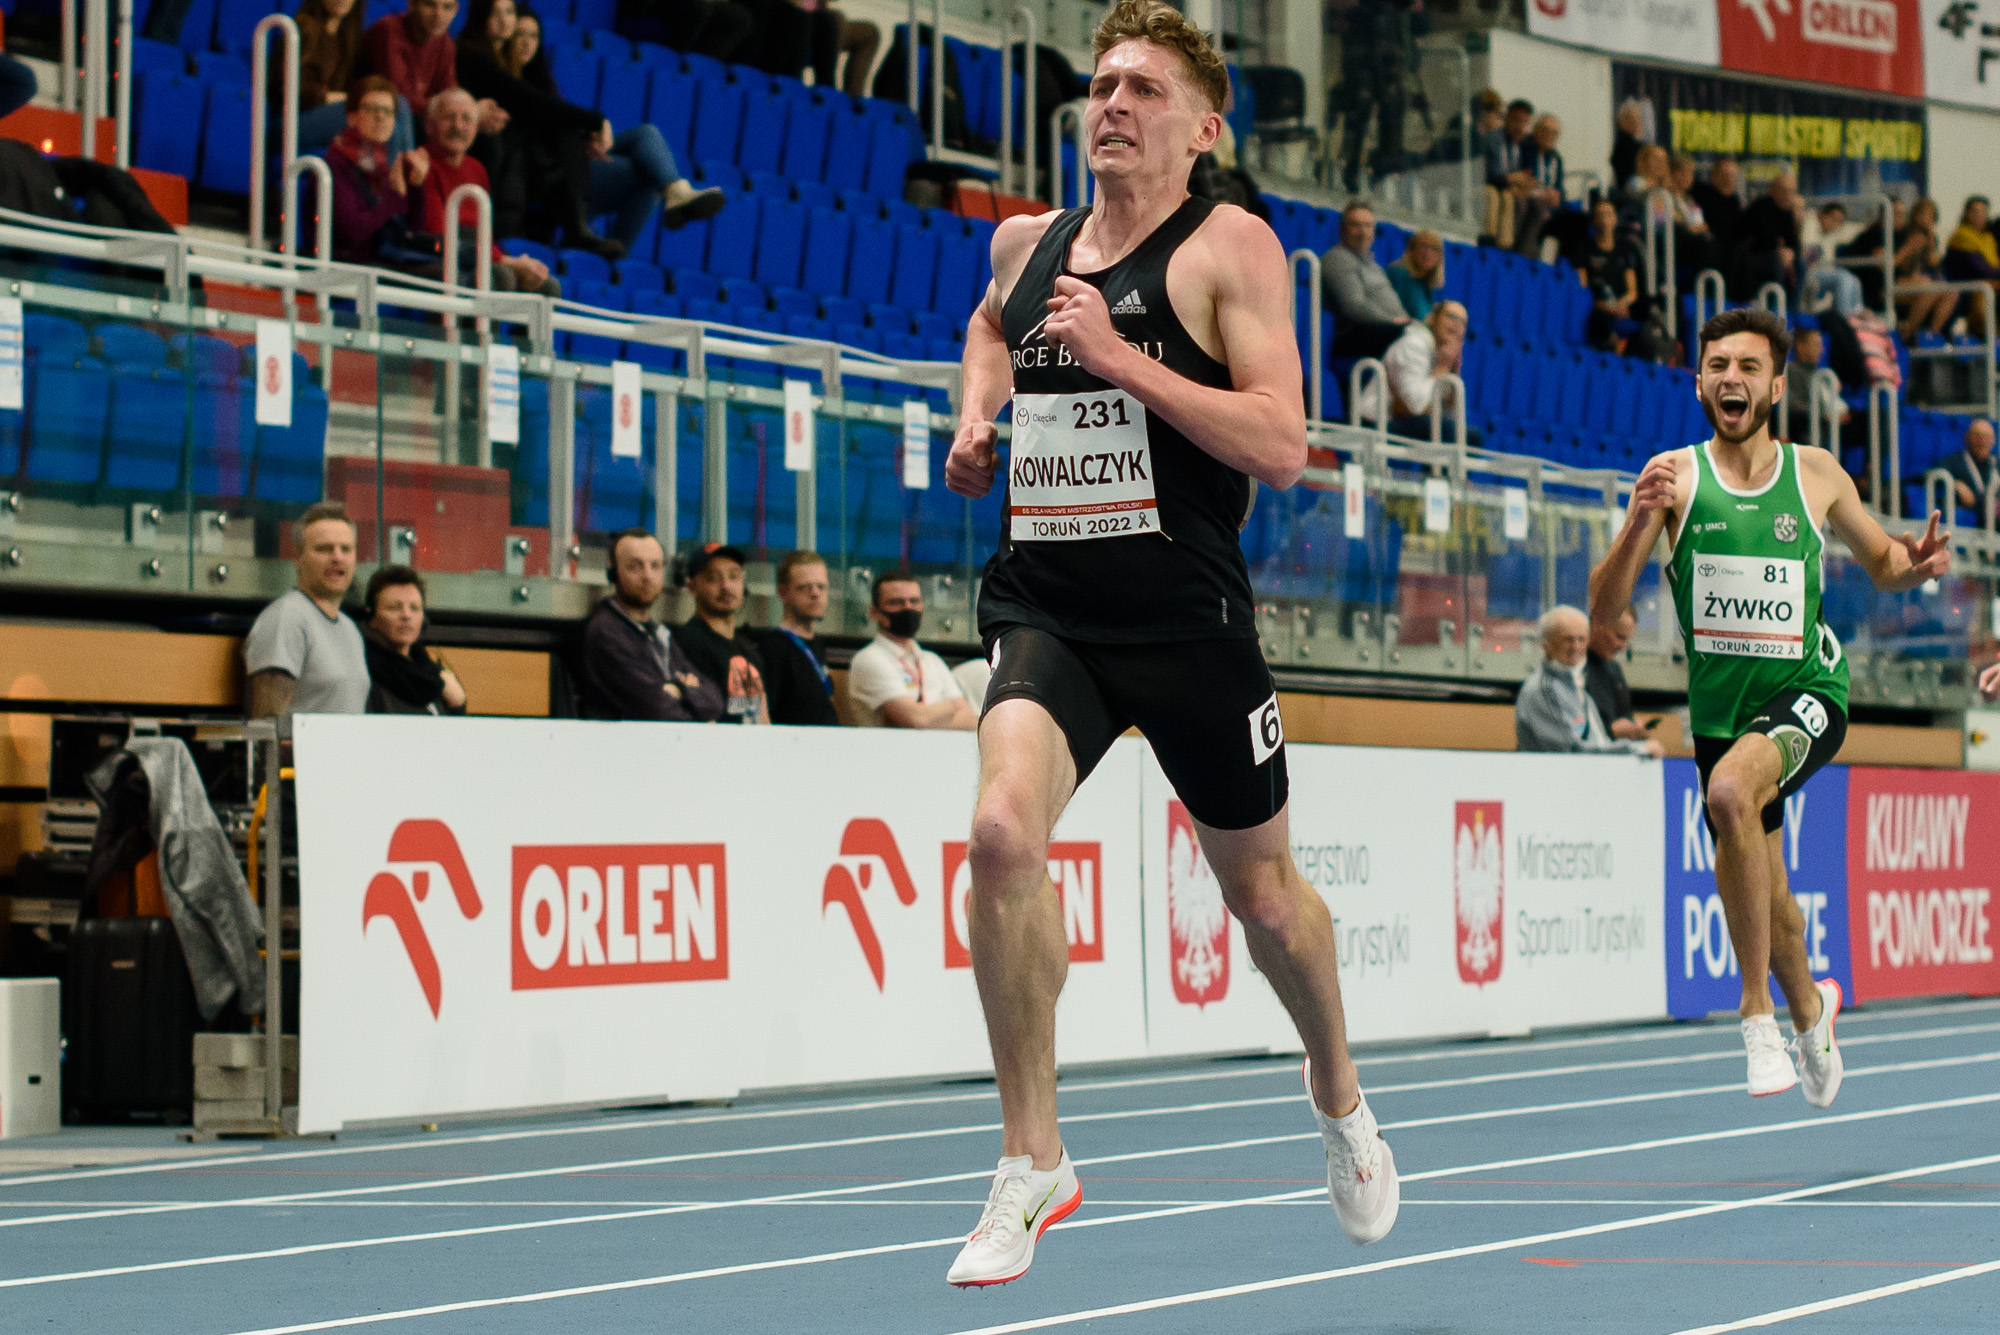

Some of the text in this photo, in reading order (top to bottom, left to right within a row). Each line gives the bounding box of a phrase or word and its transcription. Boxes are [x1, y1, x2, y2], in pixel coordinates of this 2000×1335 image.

[1111, 304, 1147, 315] adidas
[1072, 398, 1131, 429] 231
[1013, 449, 1148, 488] KOWALCZYK
[1032, 516, 1132, 537] TORUŃ 2022
[1705, 521, 1728, 531] UMCS
[1763, 564, 1789, 584] 81
[1704, 591, 1793, 622] ŻYWKO
[1711, 639, 1784, 655] TORUŃ 2022
[1260, 701, 1280, 750] 6
[1866, 793, 1970, 871] KUJAWY
[519, 863, 717, 971] ORLEN
[1866, 887, 1994, 969] POMORZE
